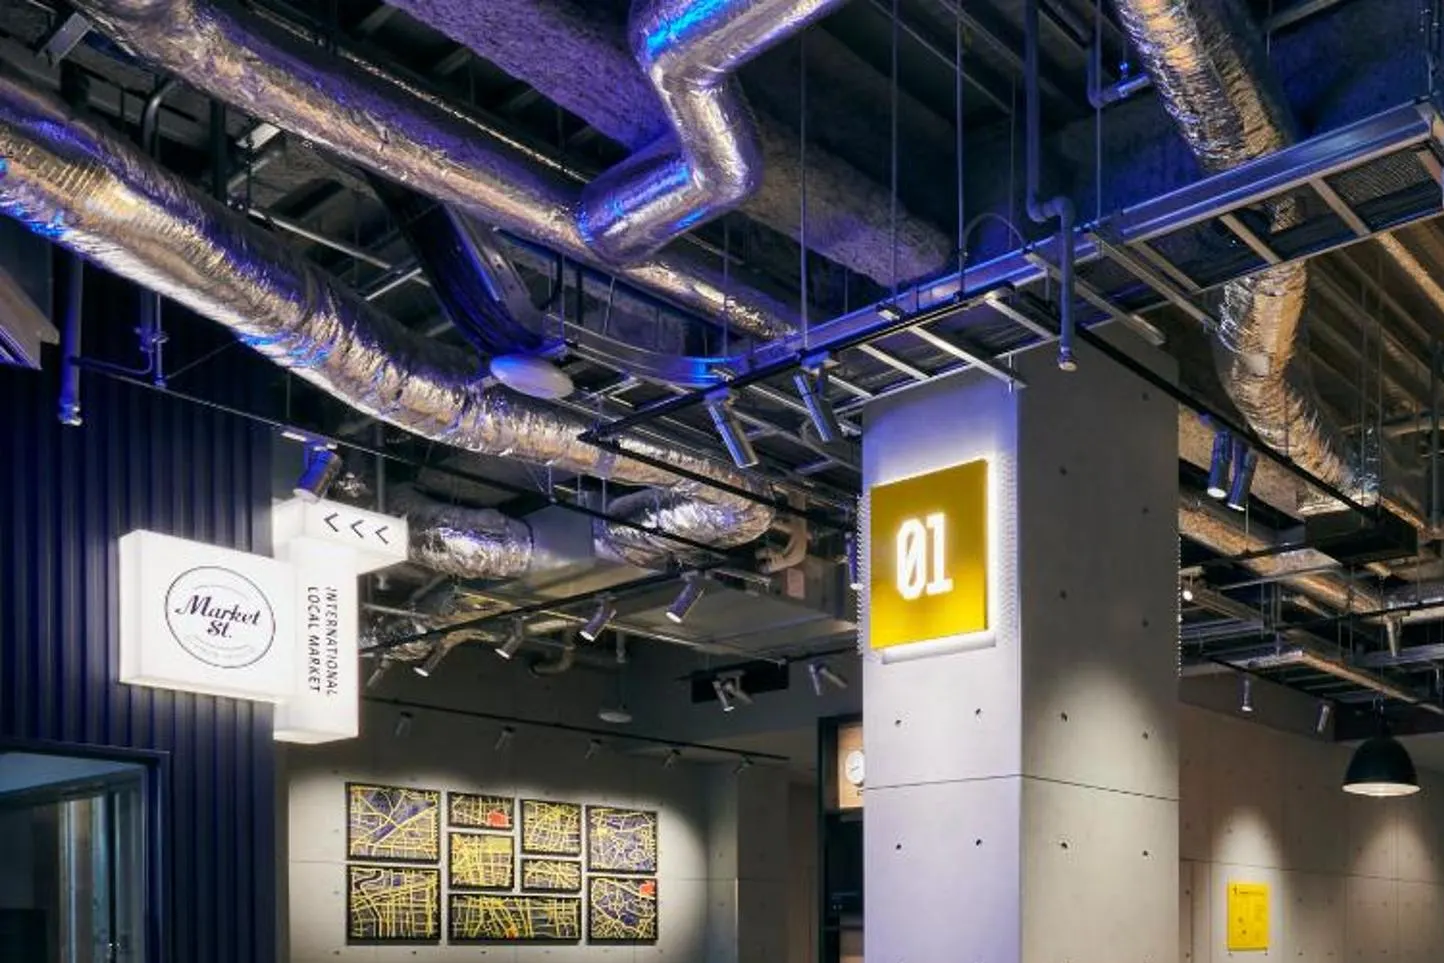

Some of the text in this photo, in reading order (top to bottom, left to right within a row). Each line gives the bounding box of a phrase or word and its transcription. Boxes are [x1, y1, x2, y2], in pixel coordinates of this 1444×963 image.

[896, 512, 953, 601] 01
[174, 594, 261, 626] Market
[207, 619, 232, 639] St.
[307, 586, 320, 693] LOCAL MARKET
[325, 585, 338, 696] INTERNATIONAL
